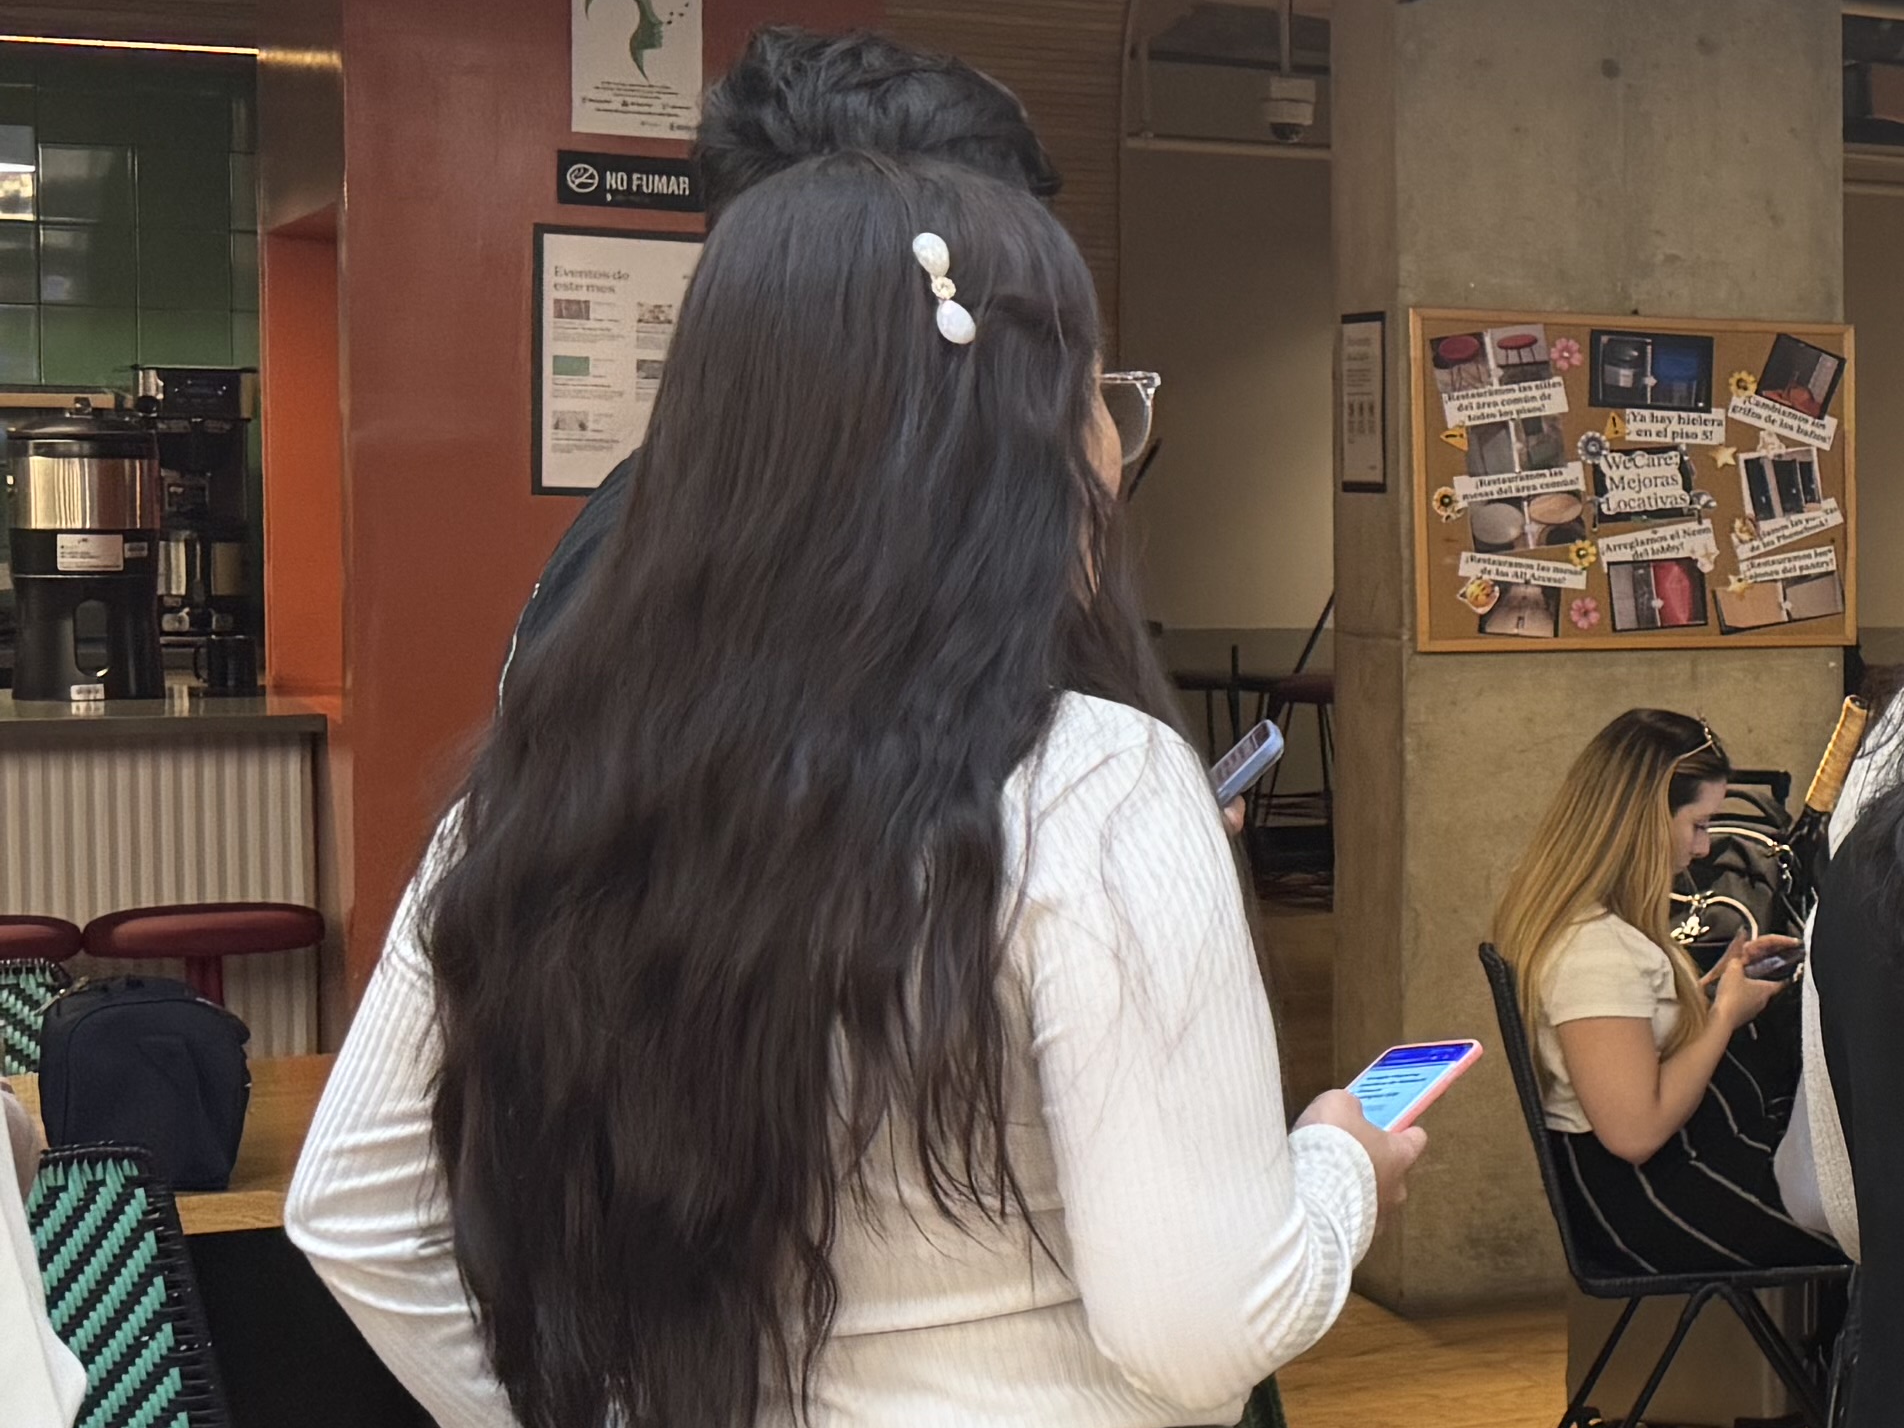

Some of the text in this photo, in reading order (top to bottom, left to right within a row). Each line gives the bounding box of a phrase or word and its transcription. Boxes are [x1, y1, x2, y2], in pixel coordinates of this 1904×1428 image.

[606, 170, 690, 196] NO FUMAR
[554, 265, 610, 279] Eventos
[1651, 412, 1674, 427] hay
[1636, 427, 1653, 438] en
[1671, 429, 1698, 443] piso
[1604, 452, 1680, 471] WeCare:
[1609, 473, 1680, 493] Mejoras
[1606, 492, 1689, 512] Locativas
